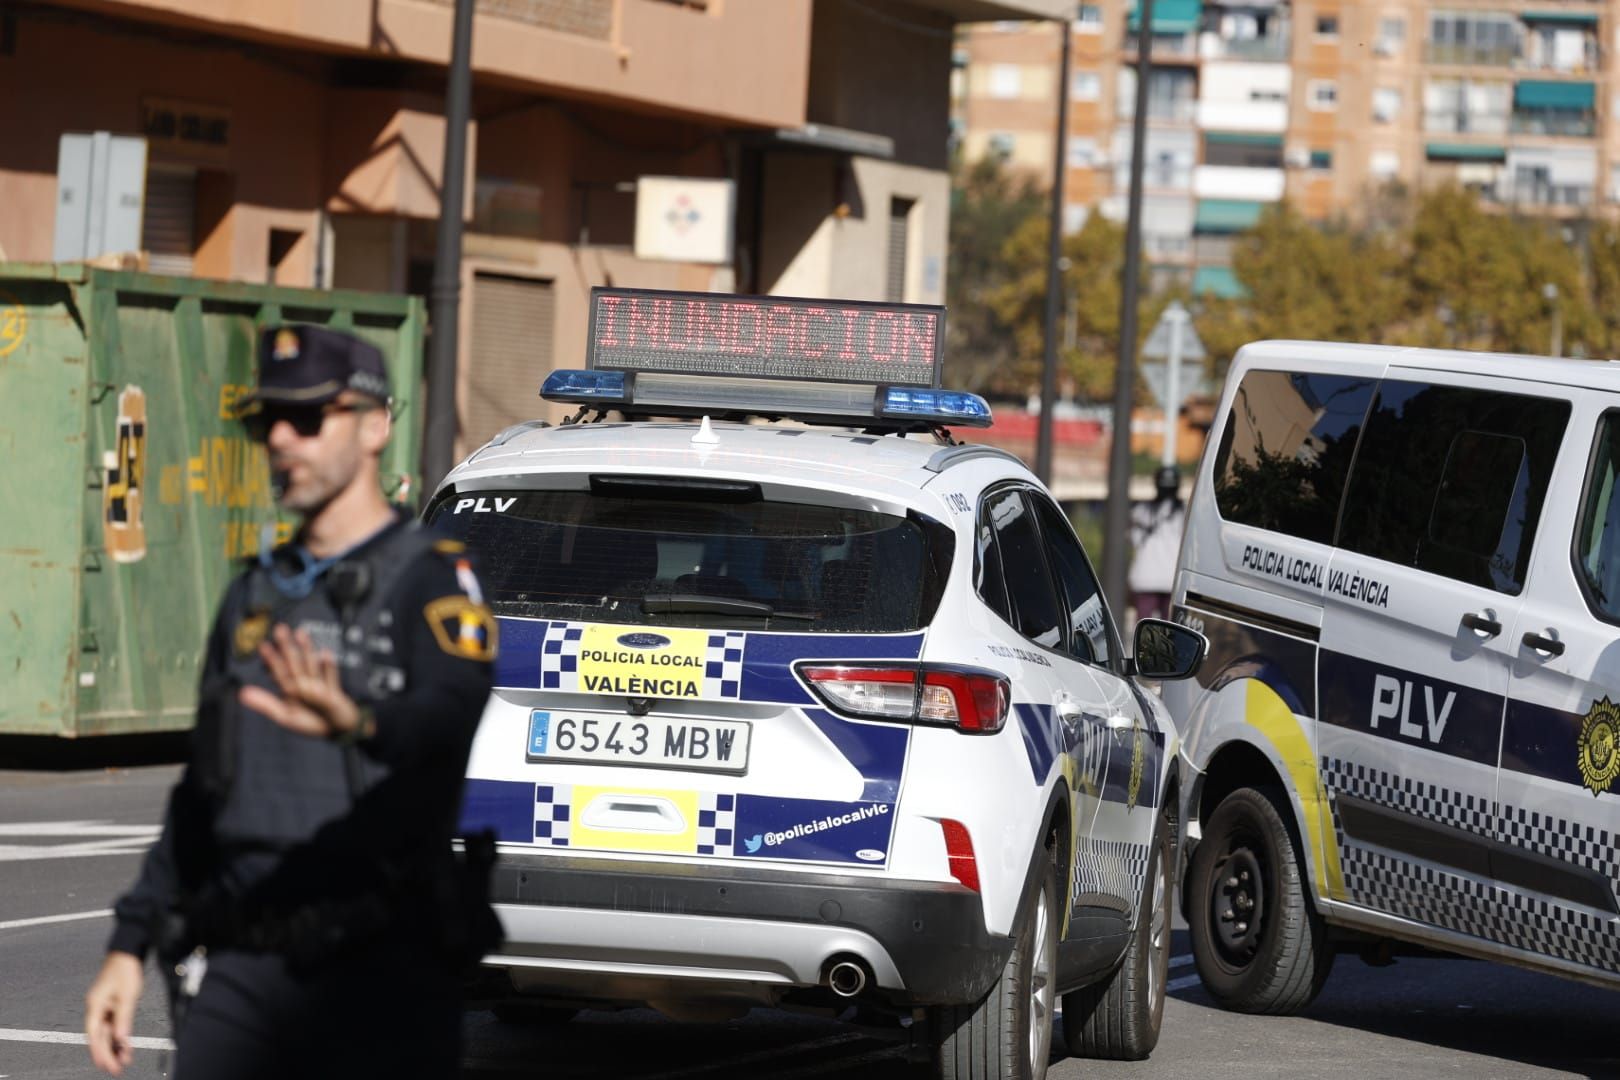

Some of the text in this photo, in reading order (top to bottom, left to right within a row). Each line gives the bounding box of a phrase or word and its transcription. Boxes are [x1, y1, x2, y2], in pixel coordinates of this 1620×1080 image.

[600, 296, 937, 363] INUNDACION
[453, 497, 517, 515] PLV
[1242, 545, 1389, 608] POLICIA LOCAL VALÈNCIA
[581, 650, 703, 668] POLICIA LOCAL
[584, 674, 699, 697] VALÈNCIA
[1370, 673, 1457, 744] PLV
[556, 718, 736, 761] 6543 MBW
[764, 804, 889, 846] @policialocalvlc
